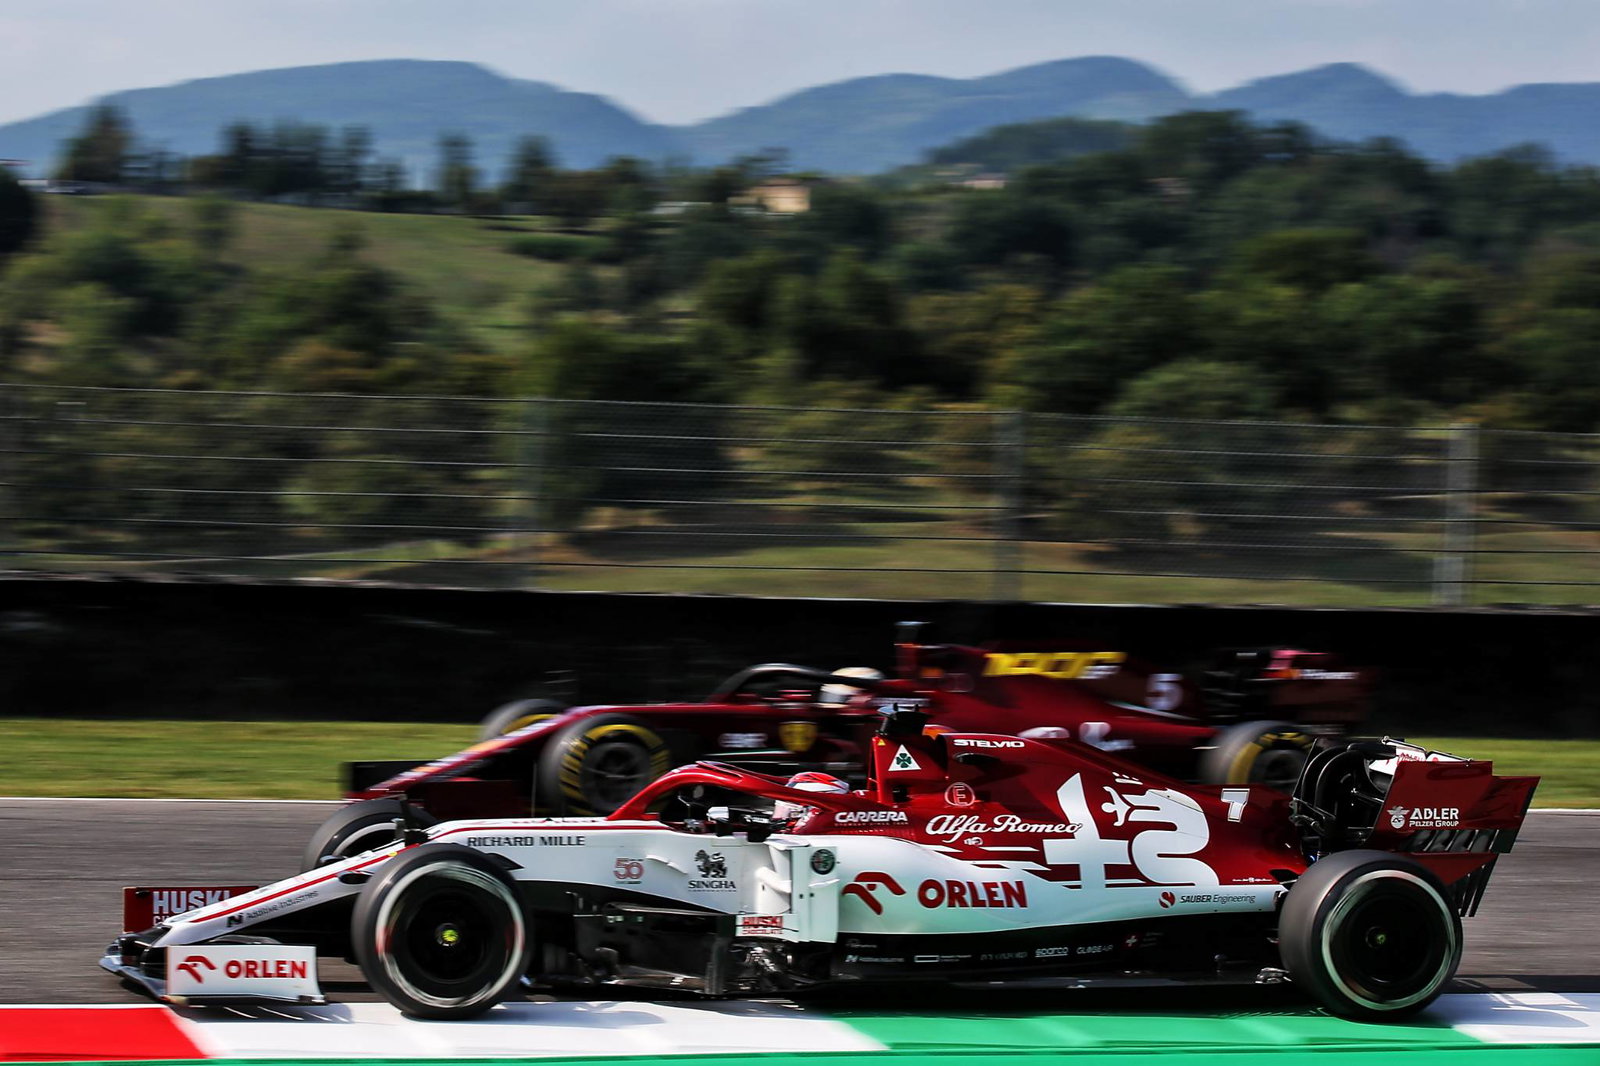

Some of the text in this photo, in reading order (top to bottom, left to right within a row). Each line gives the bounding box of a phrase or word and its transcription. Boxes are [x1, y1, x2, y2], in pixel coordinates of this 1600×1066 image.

[953, 738, 1025, 748] STELVIO
[1221, 788, 1250, 823] 7
[834, 811, 909, 823] CARRERA
[1409, 808, 1459, 820] ADLER
[925, 814, 1083, 843] Alfa Romeo
[1409, 820, 1459, 828] PELZER GROUP
[467, 836, 586, 847] RICHARD MILLE
[613, 857, 645, 880] 50
[687, 880, 737, 889] SINGHA
[917, 878, 1028, 909] ORLEN
[1180, 893, 1256, 905] SAUBER Engineering
[224, 959, 307, 979] ORLEN
